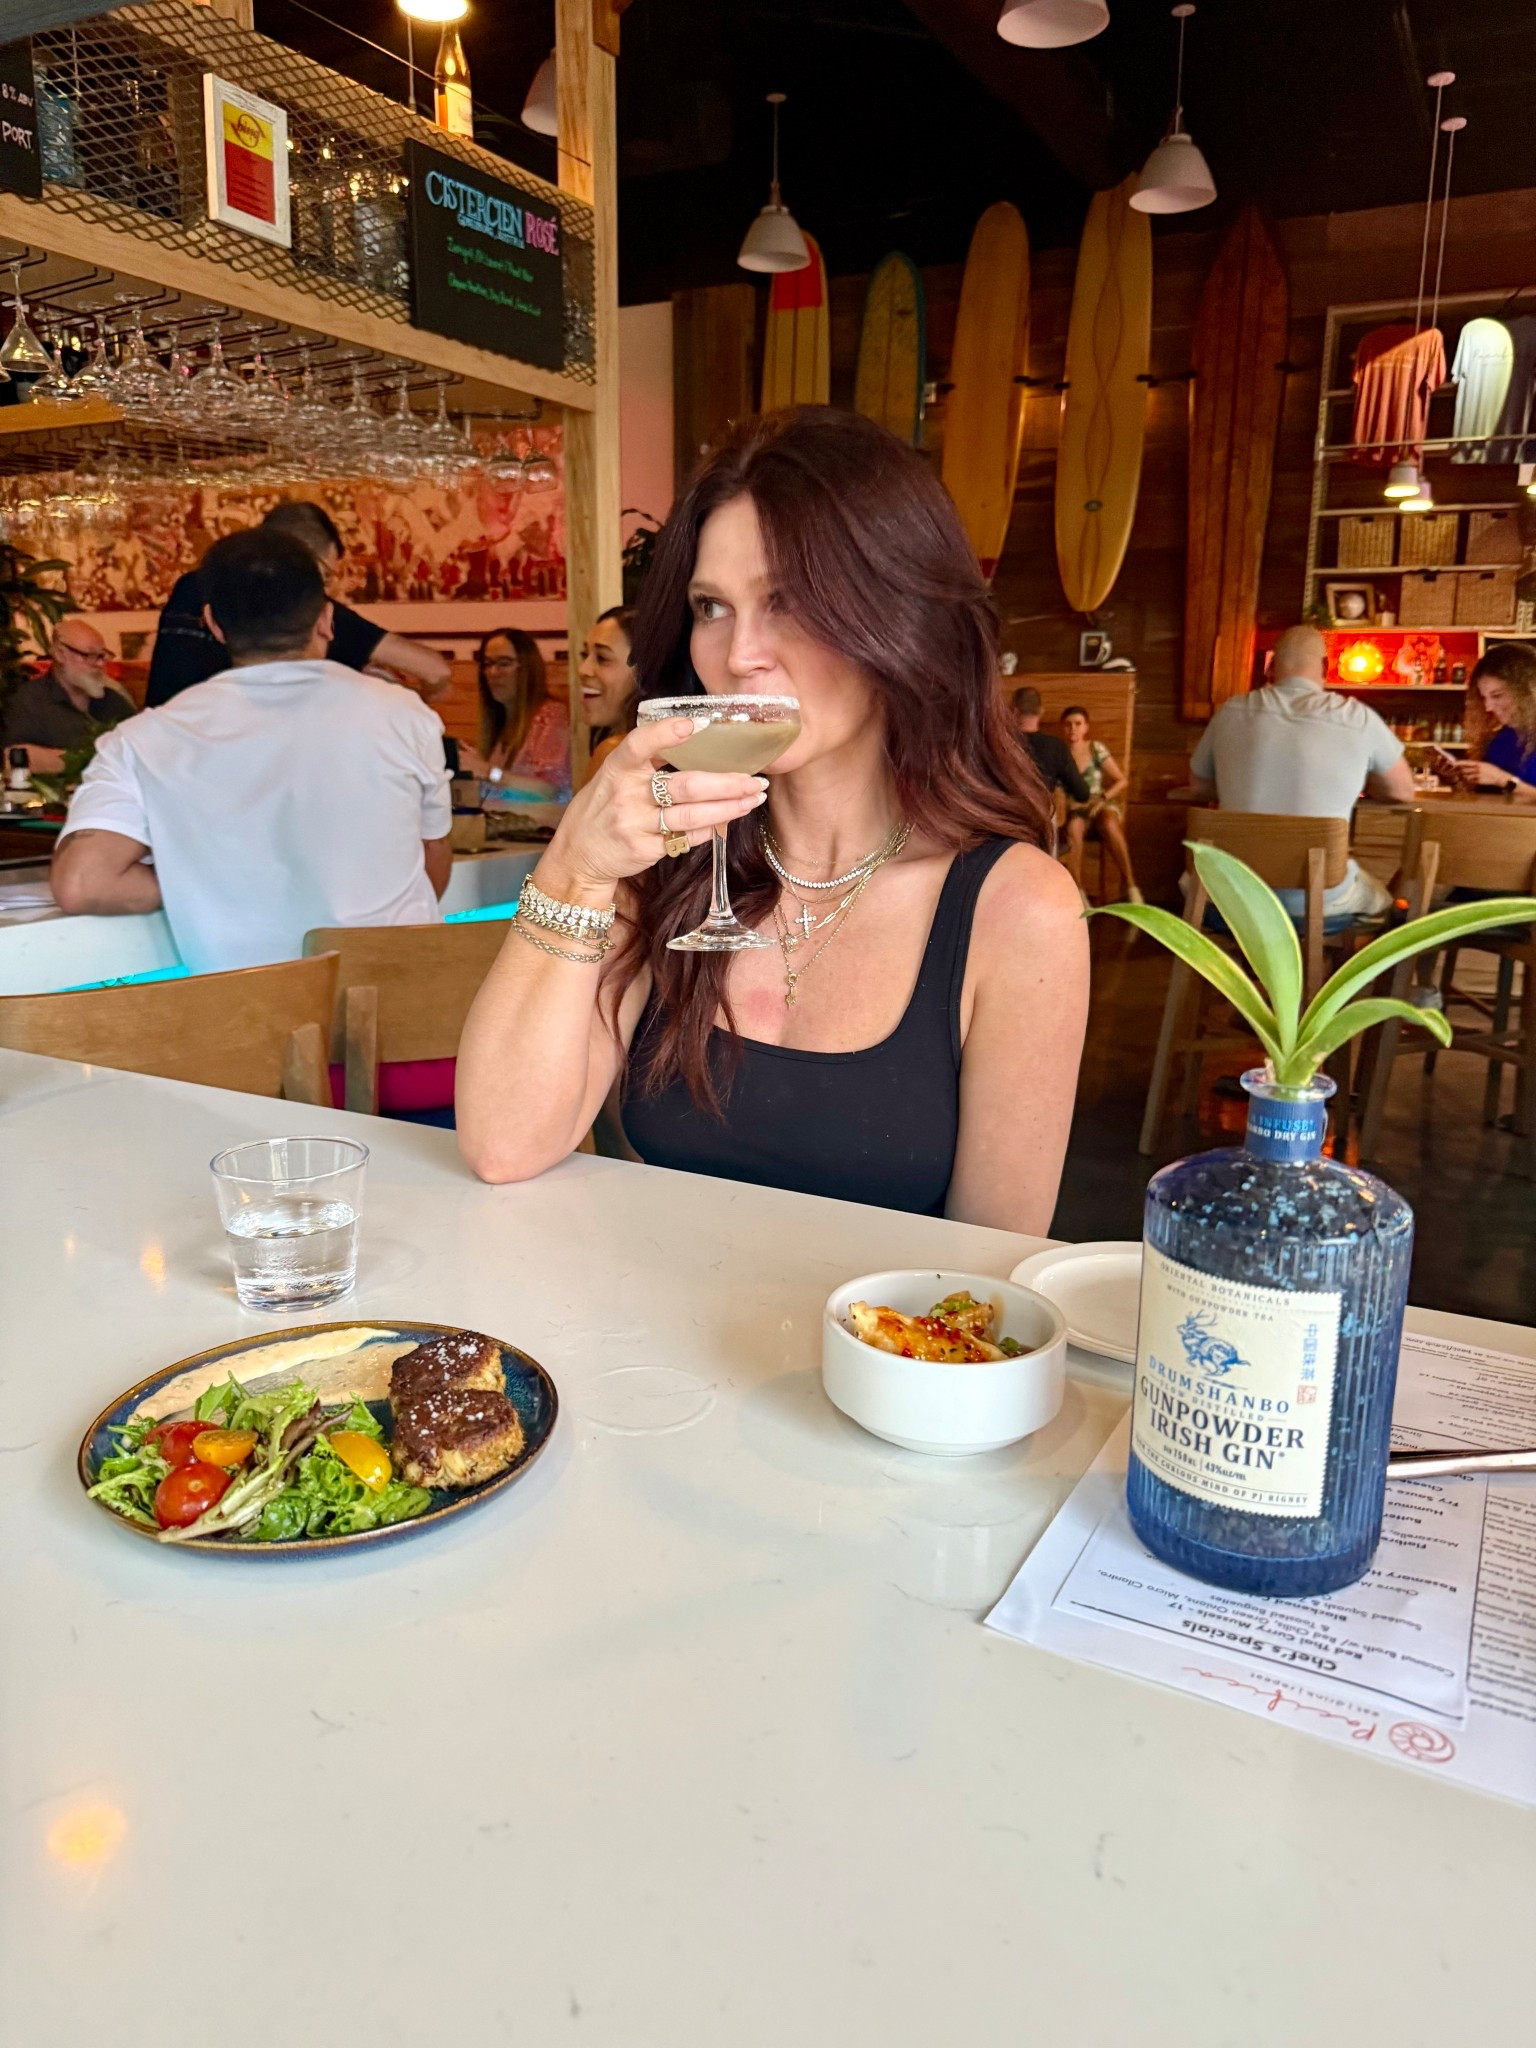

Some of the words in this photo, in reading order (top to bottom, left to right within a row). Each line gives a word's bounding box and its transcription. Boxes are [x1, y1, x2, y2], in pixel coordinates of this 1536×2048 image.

[425, 171, 523, 239] CISTERCIEN
[524, 211, 560, 256] ROSÉ
[1274, 1130, 1297, 1141] DRY
[1300, 1131, 1317, 1141] GIN
[1160, 1262, 1205, 1288] ORIENTAL
[1211, 1283, 1290, 1306] BOTANICALS
[1167, 1284, 1186, 1298] WITH
[1189, 1293, 1249, 1318] GUNPOWDER
[1148, 1355, 1290, 1414] DRUMSHANBO
[1159, 1379, 1186, 1399] SLOW
[1192, 1396, 1264, 1422] DISTILLED
[1141, 1375, 1305, 1449] GUNPOWDER
[1150, 1408, 1213, 1457] IRISH
[1161, 1460, 1198, 1483] CURIOUS
[1233, 1488, 1247, 1497] OF
[1252, 1492, 1263, 1502] PJ
[1268, 1494, 1308, 1503] RIGNEY
[1397, 1489, 1434, 1502] Sauce
[1438, 1498, 1459, 1508] Fry
[1387, 1501, 1444, 1516] Hummus
[1097, 1569, 1143, 1589] Cilantro,
[1386, 1572, 1457, 1593] Rosemary
[1147, 1585, 1180, 1599] Micro
[1167, 1602, 1184, 1610] 17
[1184, 1595, 1228, 1613] Onions,
[1209, 1595, 1267, 1615] Baguettes
[1275, 1599, 1347, 1622] Blackened
[1324, 1602, 1368, 1618] Squash
[1196, 1609, 1251, 1629] Mussels
[1232, 1609, 1269, 1626] Green
[1270, 1611, 1316, 1629] Toasted
[1181, 1620, 1264, 1651] Specials
[1256, 1625, 1295, 1641] Curry
[1313, 1632, 1337, 1644] Red
[1299, 1638, 1329, 1651] Thai
[1335, 1647, 1363, 1660] Red
[1363, 1645, 1397, 1659] Broth
[1272, 1645, 1337, 1672] Chef's
[1401, 1655, 1455, 1678] Coconut
[1182, 1667, 1376, 1742] Pacifica
